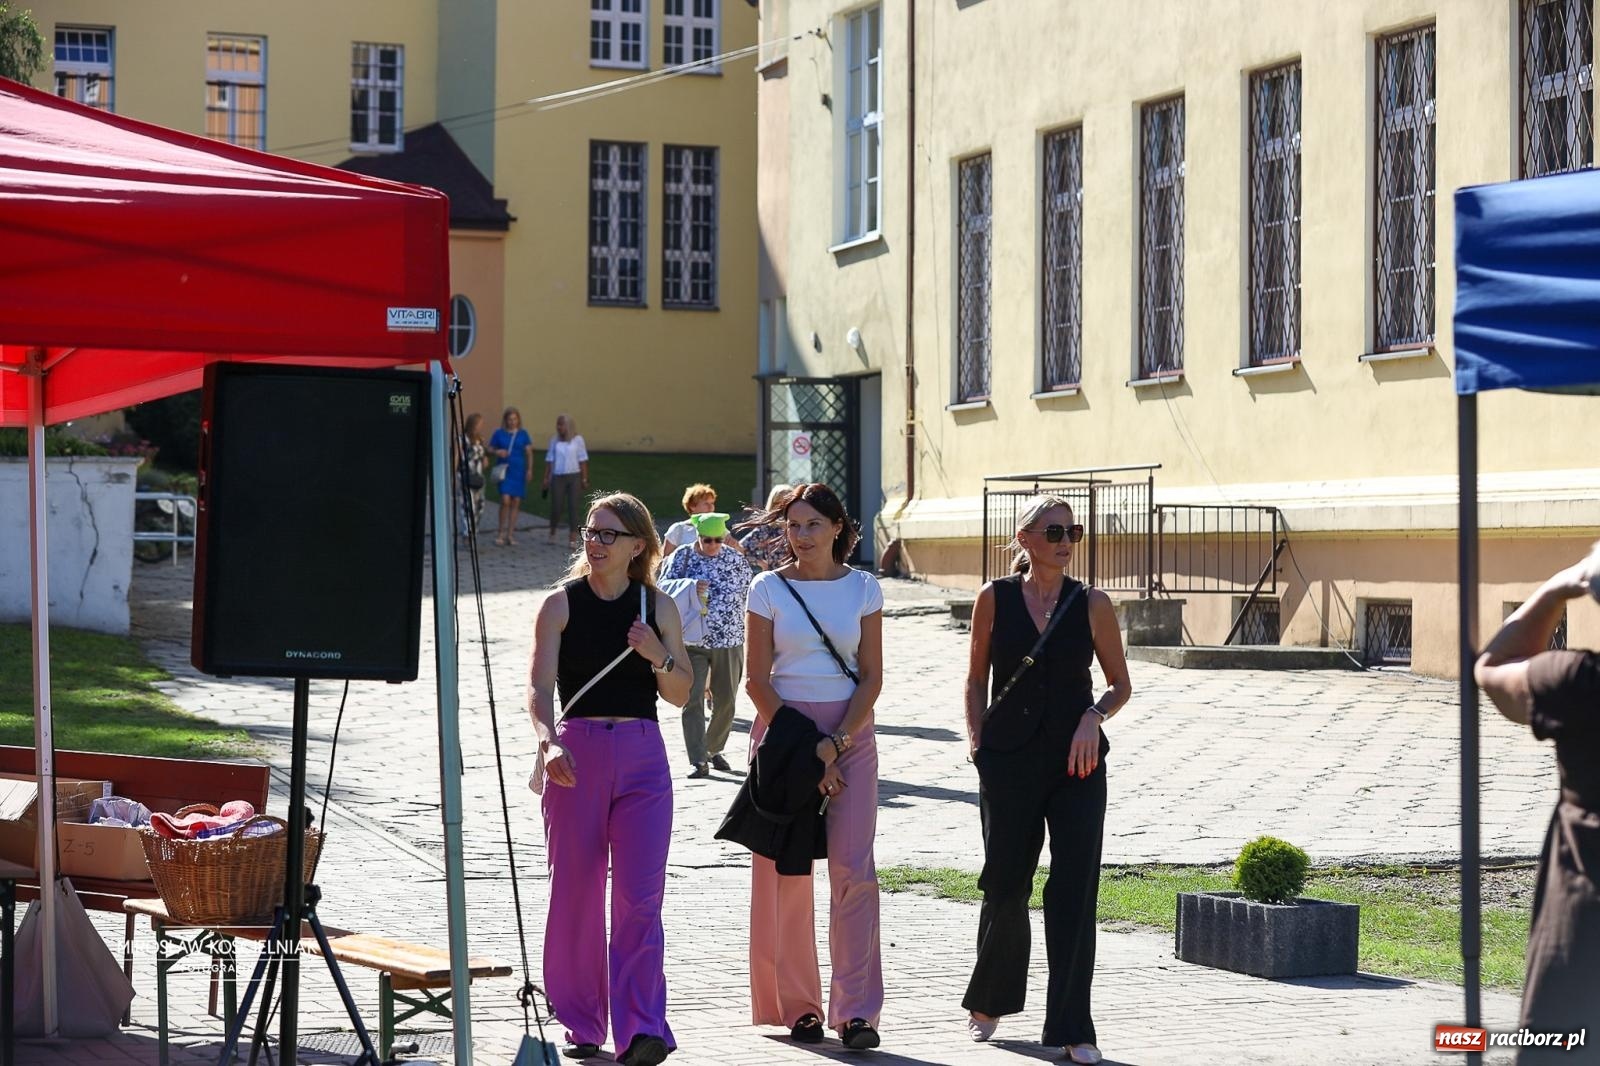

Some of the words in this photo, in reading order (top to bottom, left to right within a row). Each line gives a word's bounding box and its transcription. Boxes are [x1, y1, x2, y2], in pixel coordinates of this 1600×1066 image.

[389, 310, 434, 319] VITABRI
[286, 651, 341, 660] DYNACORD
[63, 838, 96, 856] Z-5
